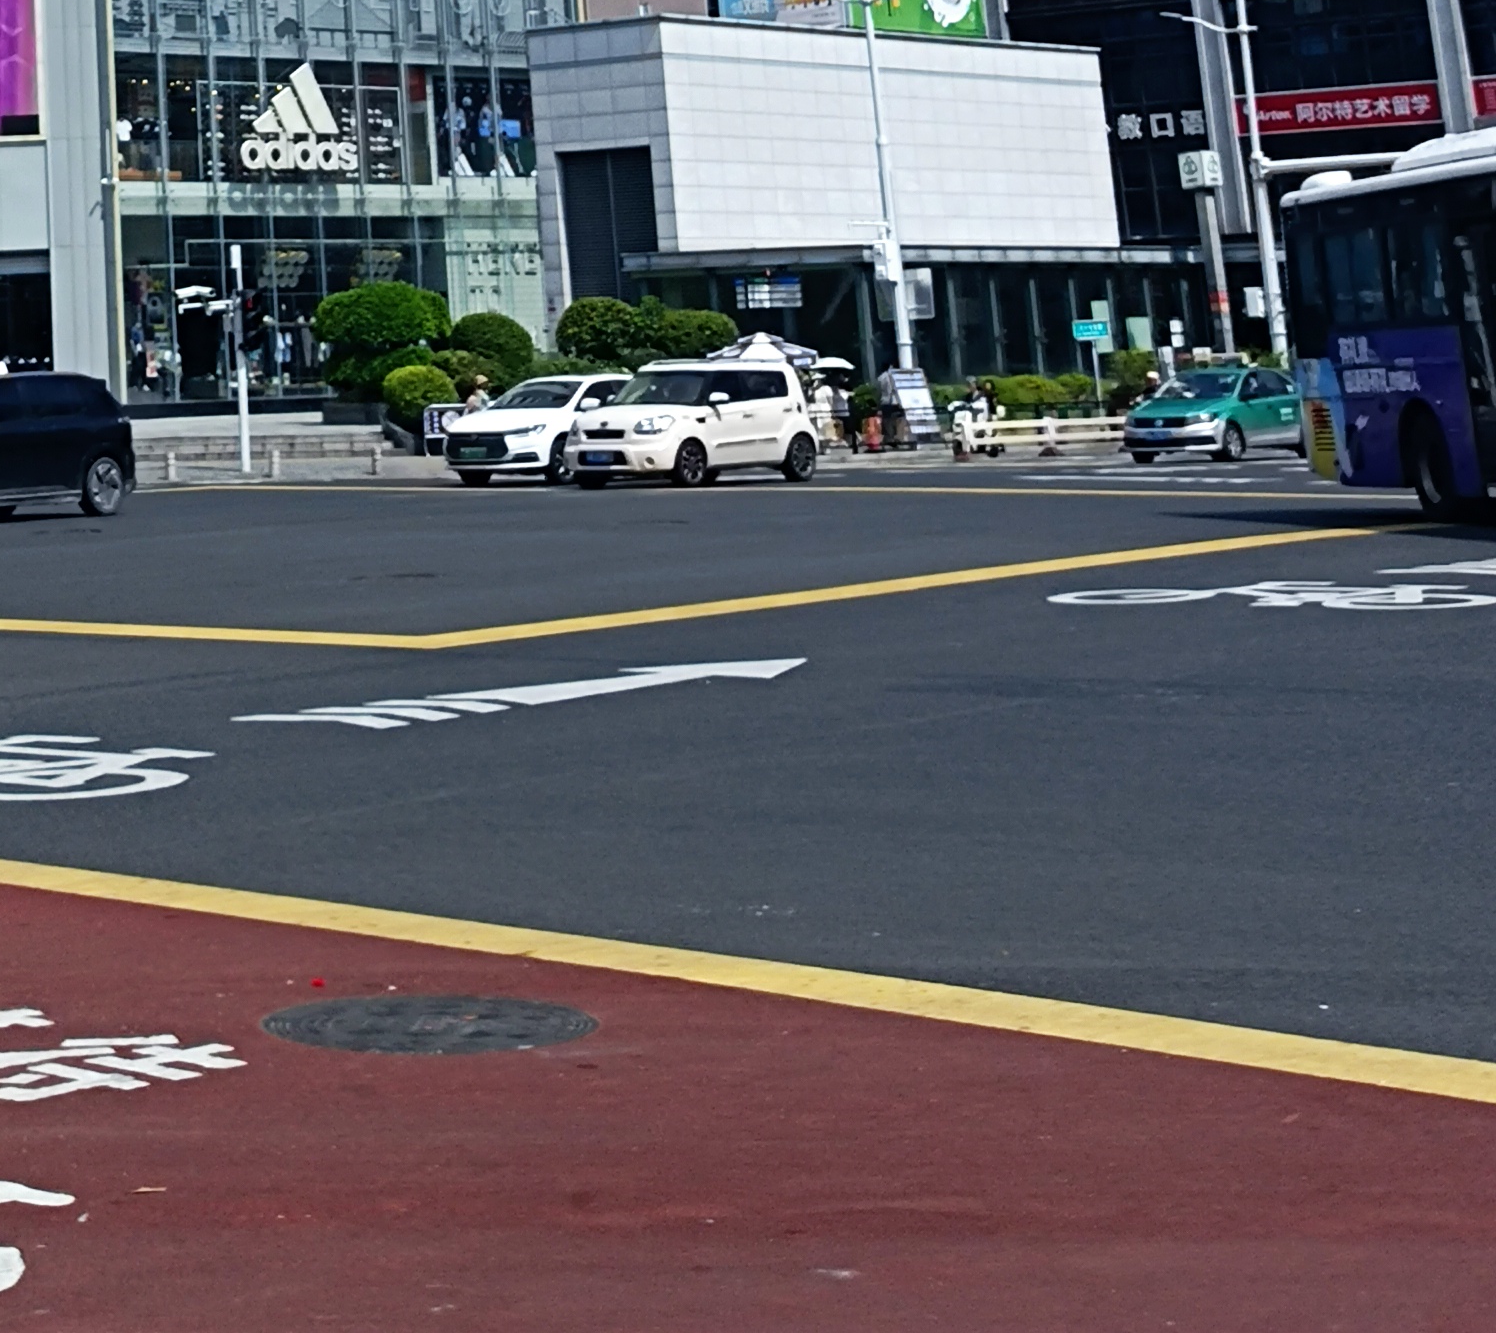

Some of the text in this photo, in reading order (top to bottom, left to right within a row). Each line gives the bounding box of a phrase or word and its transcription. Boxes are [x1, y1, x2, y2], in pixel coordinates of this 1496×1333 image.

[1295, 94, 1431, 123] 阿尔特艺术留学
[240, 131, 358, 170] adidas
